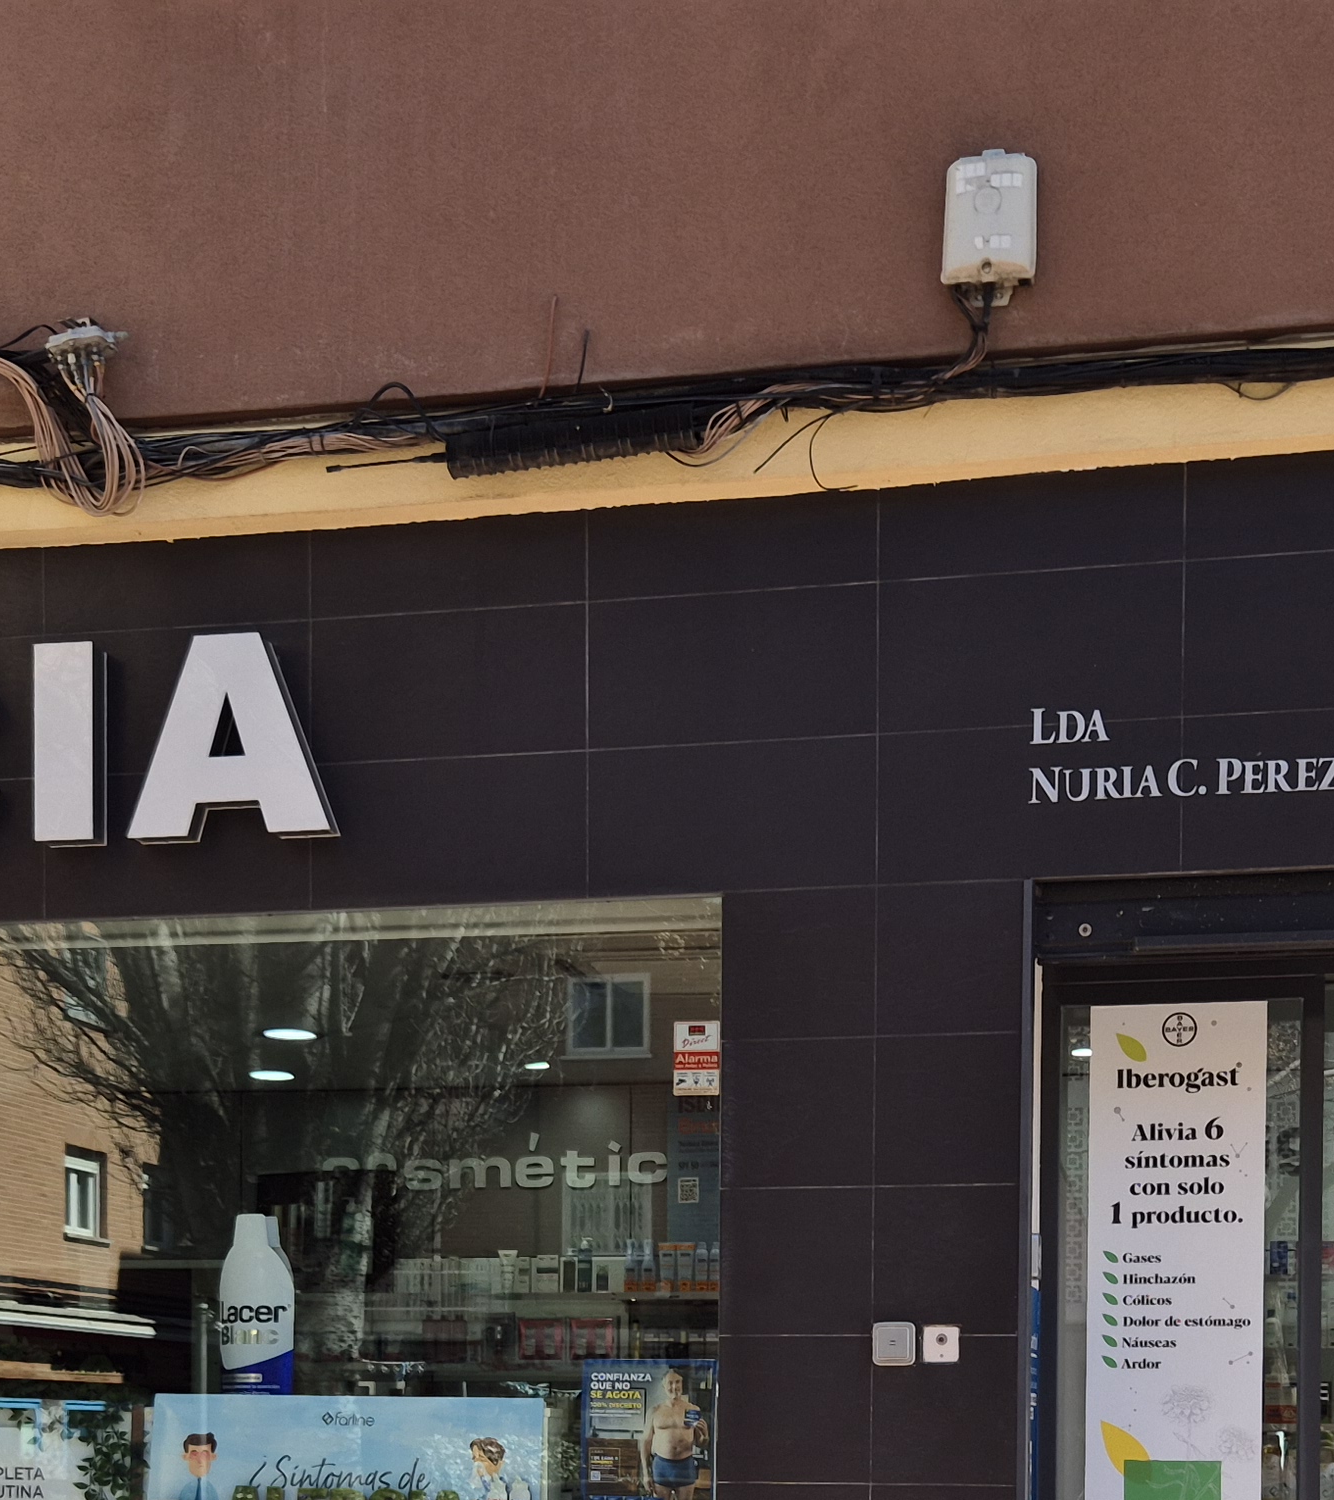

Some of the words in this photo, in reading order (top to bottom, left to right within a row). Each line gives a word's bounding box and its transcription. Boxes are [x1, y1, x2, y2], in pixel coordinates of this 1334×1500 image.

[1030, 708, 1110, 744] LDA
[1028, 766, 1162, 804] NURIA
[1167, 758, 1207, 797] C.
[675, 1054, 718, 1064] Alarma
[1116, 1066, 1239, 1093] Iberogast
[1131, 1122, 1197, 1141] Alivia
[1204, 1116, 1224, 1141] 6
[1124, 1150, 1230, 1169] síntomas
[1129, 1180, 1171, 1196] con
[1177, 1177, 1224, 1195] solo
[1110, 1202, 1123, 1224] 1
[1131, 1206, 1244, 1229] producto.
[1122, 1251, 1162, 1264] Gases
[1122, 1273, 1196, 1285] Hinchazón
[1122, 1293, 1172, 1306] Cólicos
[1122, 1315, 1161, 1327] Dolor
[1164, 1315, 1181, 1327] de
[1184, 1315, 1251, 1330] estómago
[1121, 1336, 1177, 1349] Náuseas
[1121, 1358, 1162, 1370] Ardor
[590, 1372, 652, 1382] CONFIANZA
[590, 1381, 612, 1390] QUE
[614, 1381, 631, 1390] NO
[590, 1390, 603, 1399] SE
[605, 1390, 641, 1399] AGOTA
[398, 1457, 431, 1491] de
